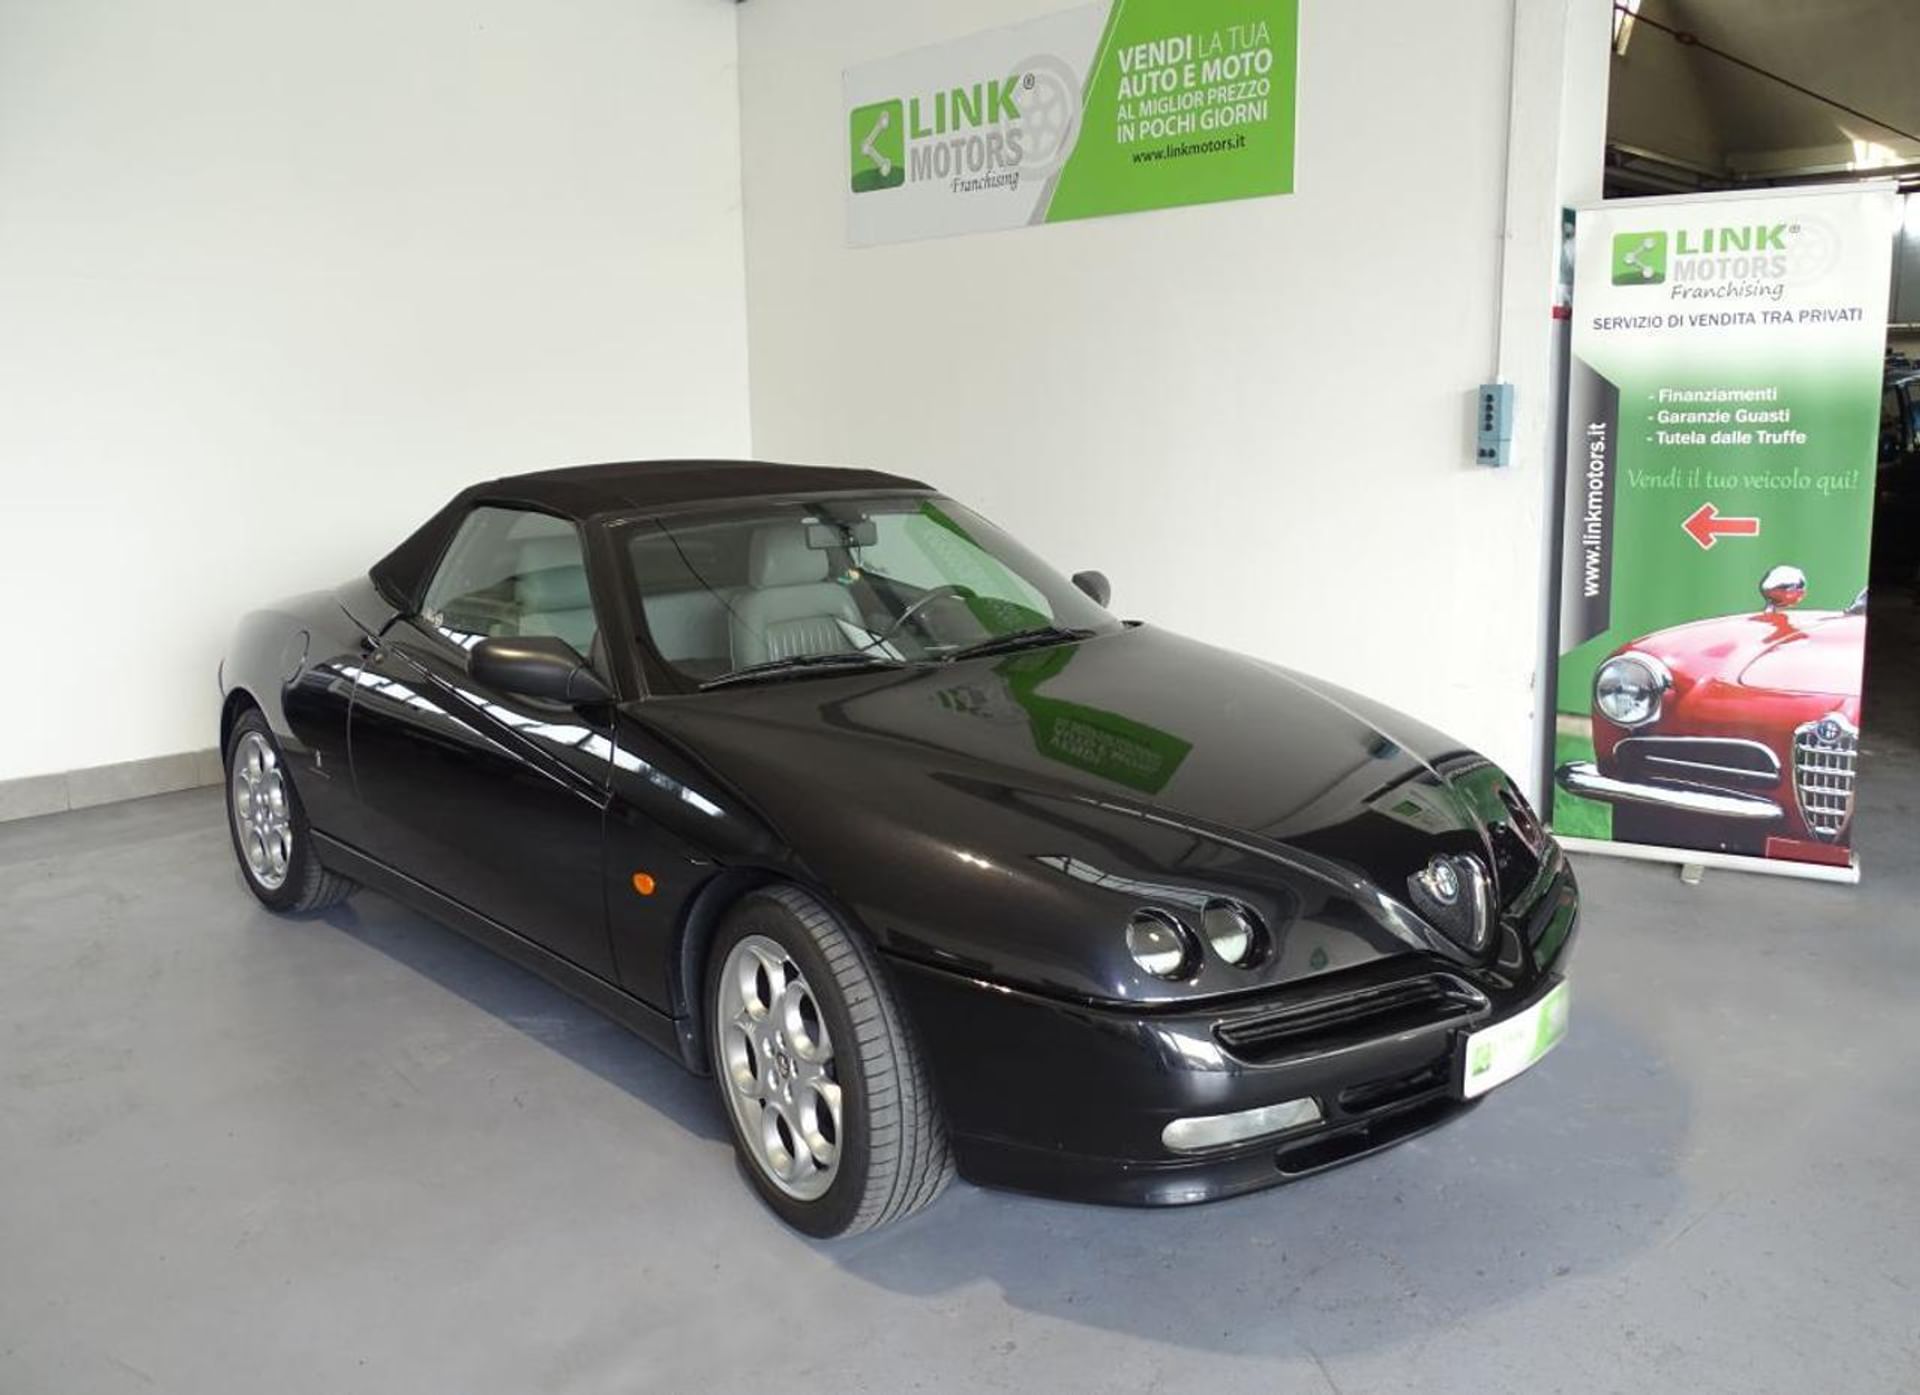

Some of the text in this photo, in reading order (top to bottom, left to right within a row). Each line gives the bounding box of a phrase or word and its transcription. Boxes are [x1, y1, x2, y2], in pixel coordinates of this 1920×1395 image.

[1118, 21, 1270, 74] VENDI LA TUA
[1117, 47, 1273, 100] AUTO E MOTO
[1117, 78, 1270, 122] AL MIGLIOR PREZZO
[1117, 99, 1268, 143] IN POCHI GIORNI
[910, 127, 1023, 183] MOTORS
[1132, 134, 1246, 163] www.linkmotors.it
[951, 170, 1019, 193] Franchising
[1673, 255, 1787, 282] MOTORS
[1671, 280, 1784, 301] Franchising
[1593, 307, 1863, 331] SERVIZIO DI VENDITA TRA PRIVATI
[1659, 388, 1777, 402] Finanziamenti
[1657, 410, 1730, 424] Garanzie
[1735, 408, 1790, 423] Guasti
[1656, 431, 1706, 445] Tutela
[1710, 431, 1752, 445] dalle
[1757, 430, 1807, 445] Truffe
[1628, 467, 1859, 496] Vendi il tuo veicolo qui!
[1582, 422, 1607, 597] www.linkmotors.it
